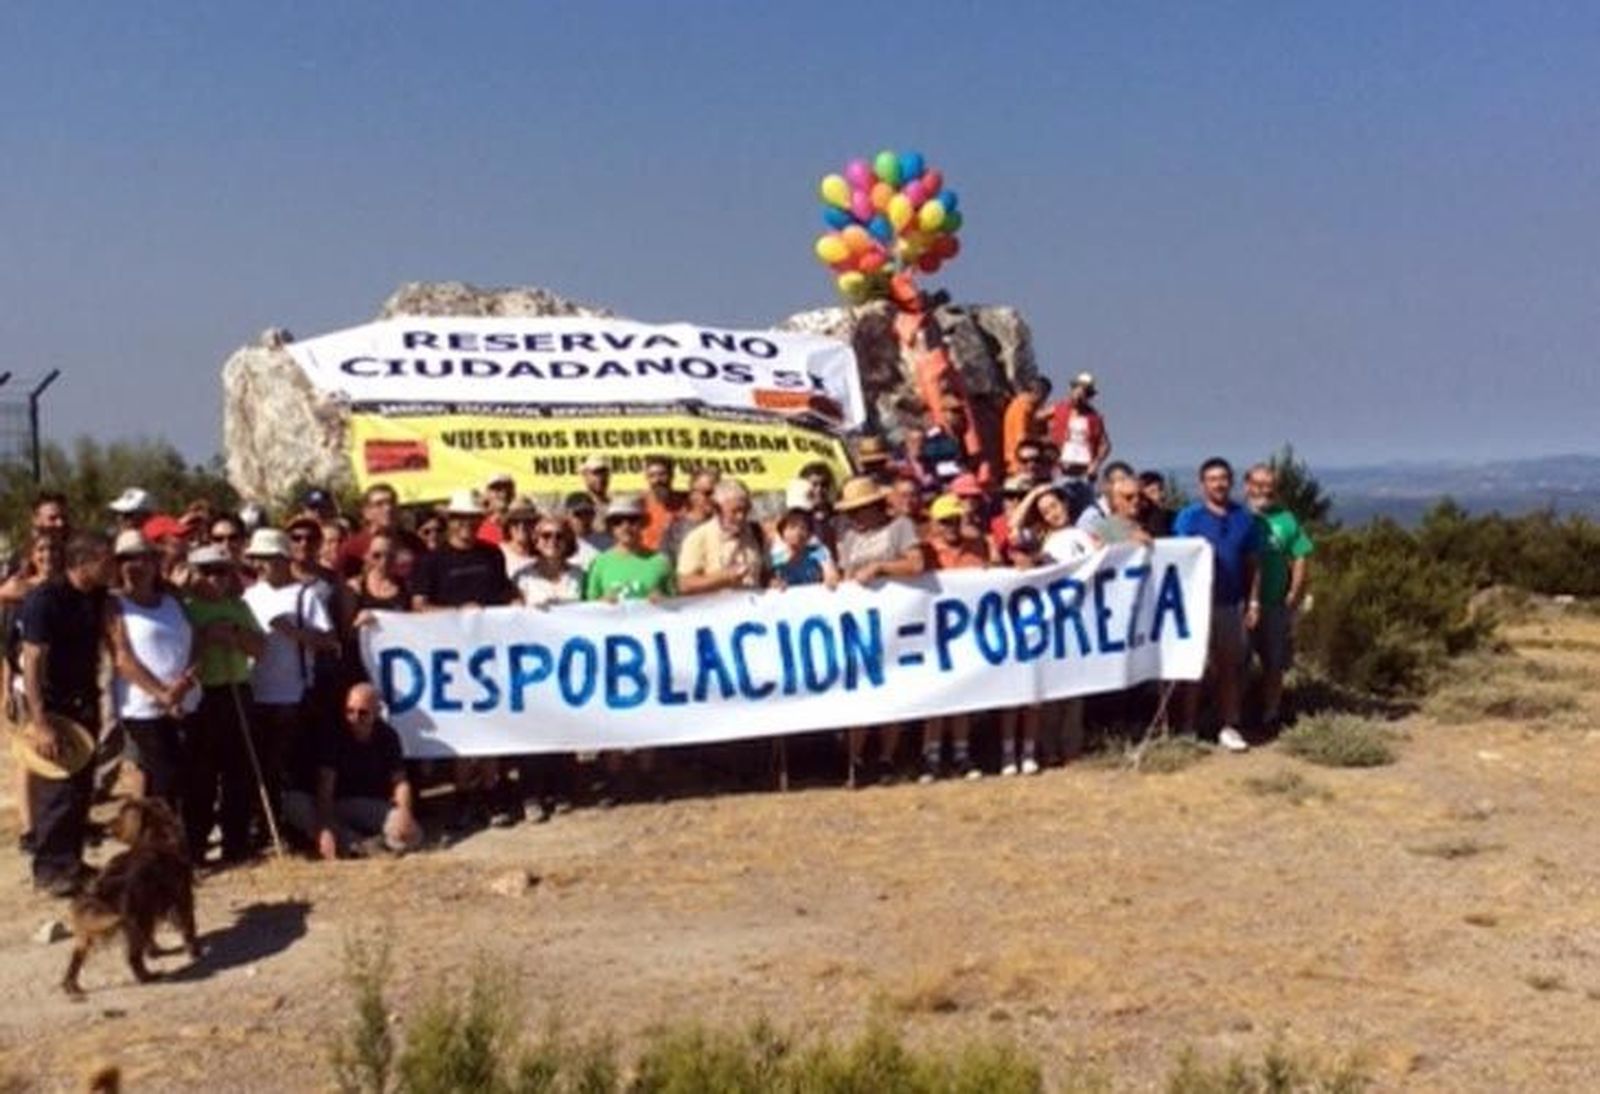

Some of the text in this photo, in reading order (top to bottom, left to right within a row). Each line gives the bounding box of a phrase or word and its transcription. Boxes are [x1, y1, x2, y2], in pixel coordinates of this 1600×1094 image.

[402, 331, 778, 359] RESERVA NO
[340, 356, 755, 384] CIUDADANOS
[440, 429, 567, 451] VUESTROS
[574, 428, 694, 450] RECORTES
[700, 429, 790, 452] ACABAN
[379, 606, 885, 715] DESPOBLACION
[934, 563, 1191, 672] POBREZA
